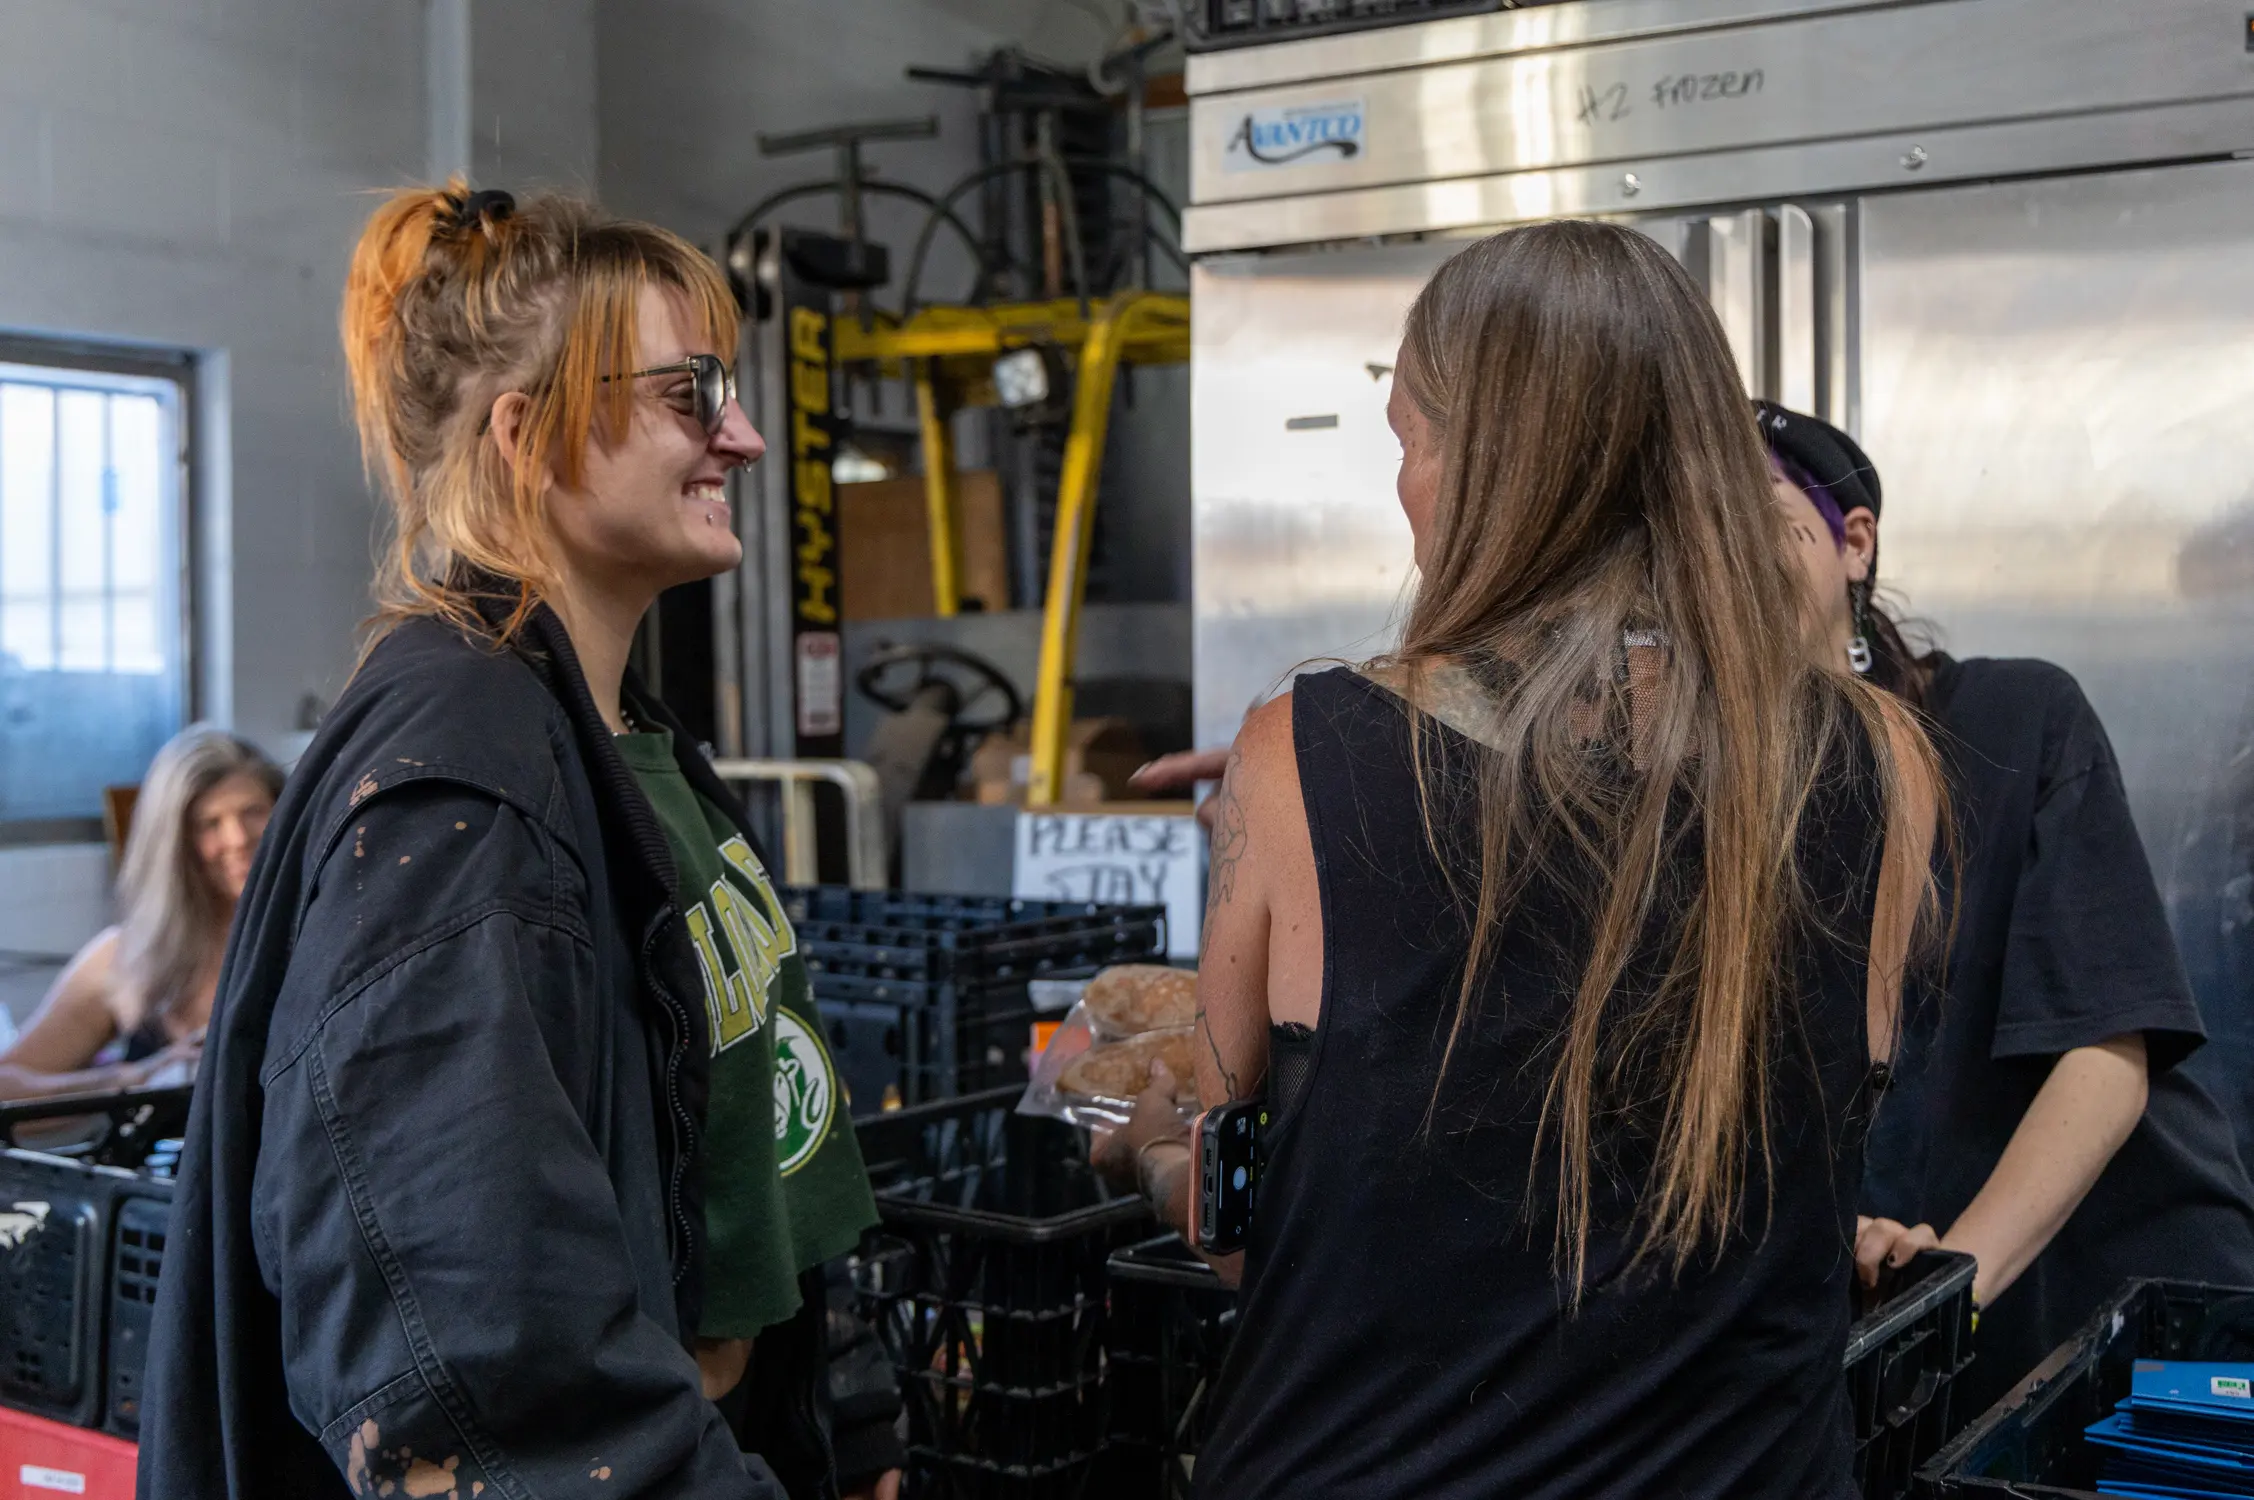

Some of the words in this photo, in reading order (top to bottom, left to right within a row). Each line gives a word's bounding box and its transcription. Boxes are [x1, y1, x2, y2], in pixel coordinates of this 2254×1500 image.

[790, 305, 836, 623] HYSTER
[1030, 815, 1191, 858] PLEASE
[1045, 859, 1168, 902] STAY
